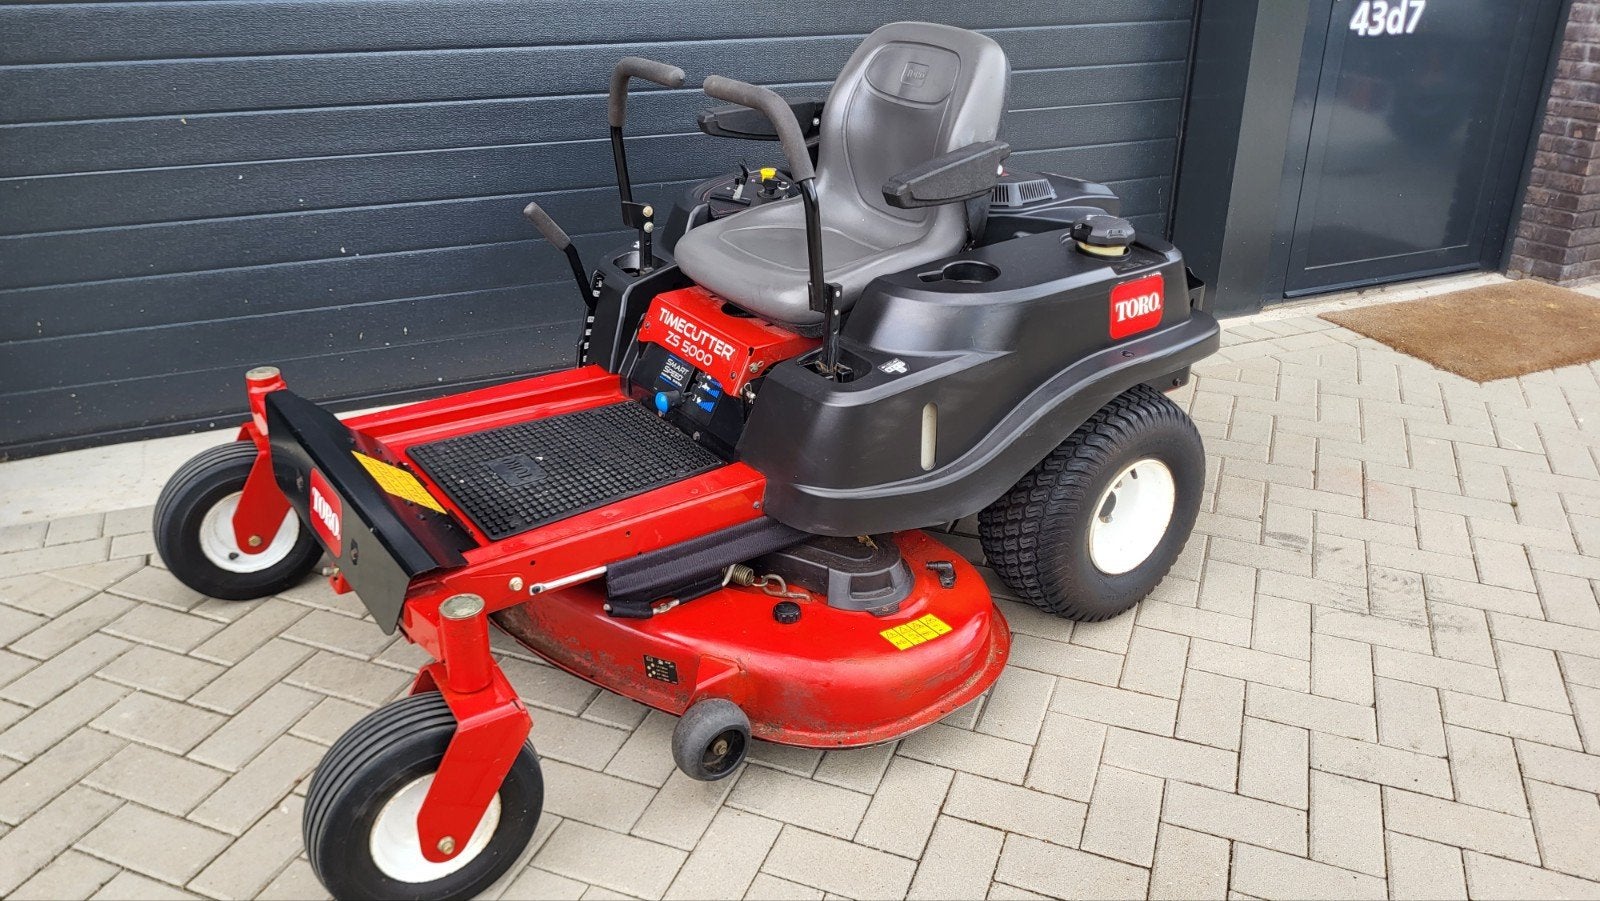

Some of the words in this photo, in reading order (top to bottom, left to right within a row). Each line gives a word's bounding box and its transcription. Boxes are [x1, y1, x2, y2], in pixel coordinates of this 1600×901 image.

[1349, 0, 1426, 36] 43d7
[1115, 292, 1160, 321] TORO
[659, 309, 735, 361] TIMECUTTER
[665, 331, 681, 347] ZS
[681, 341, 713, 366] 5000
[663, 365, 683, 381] SPEED
[666, 358, 689, 375] SMART
[311, 486, 340, 537] TORO
